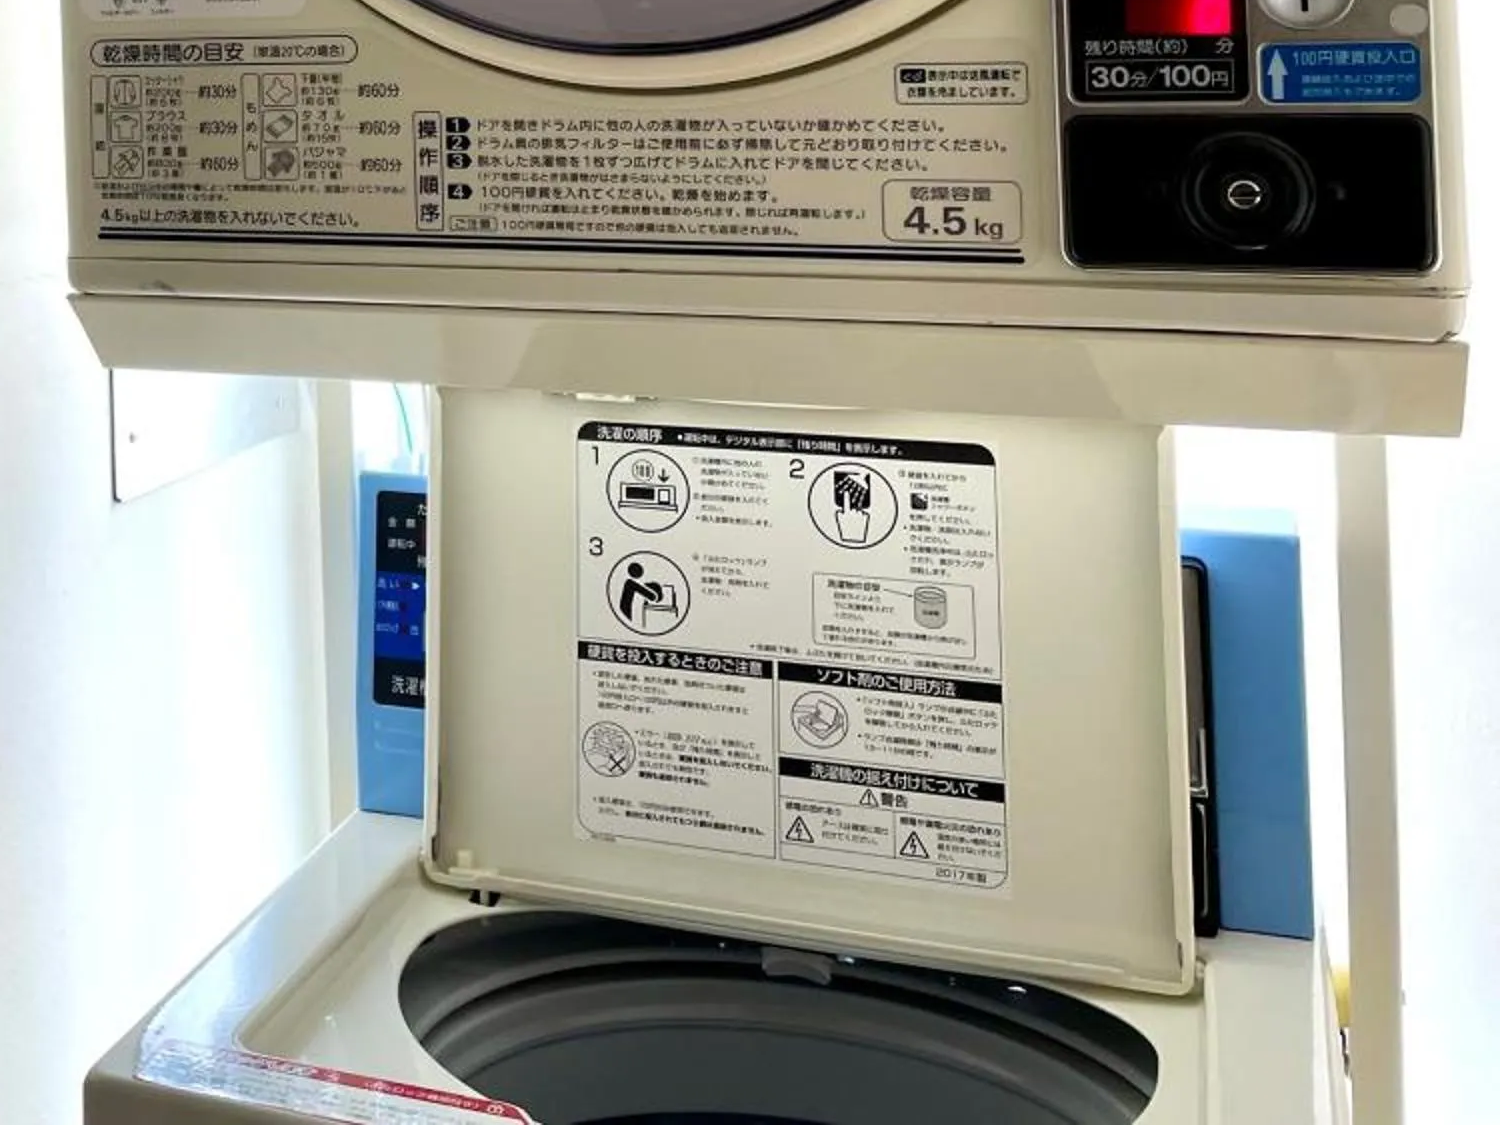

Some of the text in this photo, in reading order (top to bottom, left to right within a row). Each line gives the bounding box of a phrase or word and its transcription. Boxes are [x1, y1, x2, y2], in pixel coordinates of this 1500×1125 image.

[103, 42, 245, 63] 乾燥時間の目安
[1215, 38, 1234, 55] 分
[1293, 48, 1416, 66] 100円硬貨投入口
[358, 83, 401, 98] 約60分
[359, 120, 402, 136] 約60分
[451, 136, 463, 150] 2
[452, 154, 464, 168] 3
[417, 119, 441, 223] 操作順序
[910, 186, 992, 202] 乾燥容量
[903, 206, 1004, 239] 4.5 kg
[596, 426, 664, 443] 洗濯の順序
[591, 446, 601, 465] 1
[789, 458, 806, 480] 2
[588, 537, 604, 557] 3
[586, 644, 764, 676] 硬貨を投入するときのご注意
[816, 667, 958, 698] ソフト剤のご使用方法
